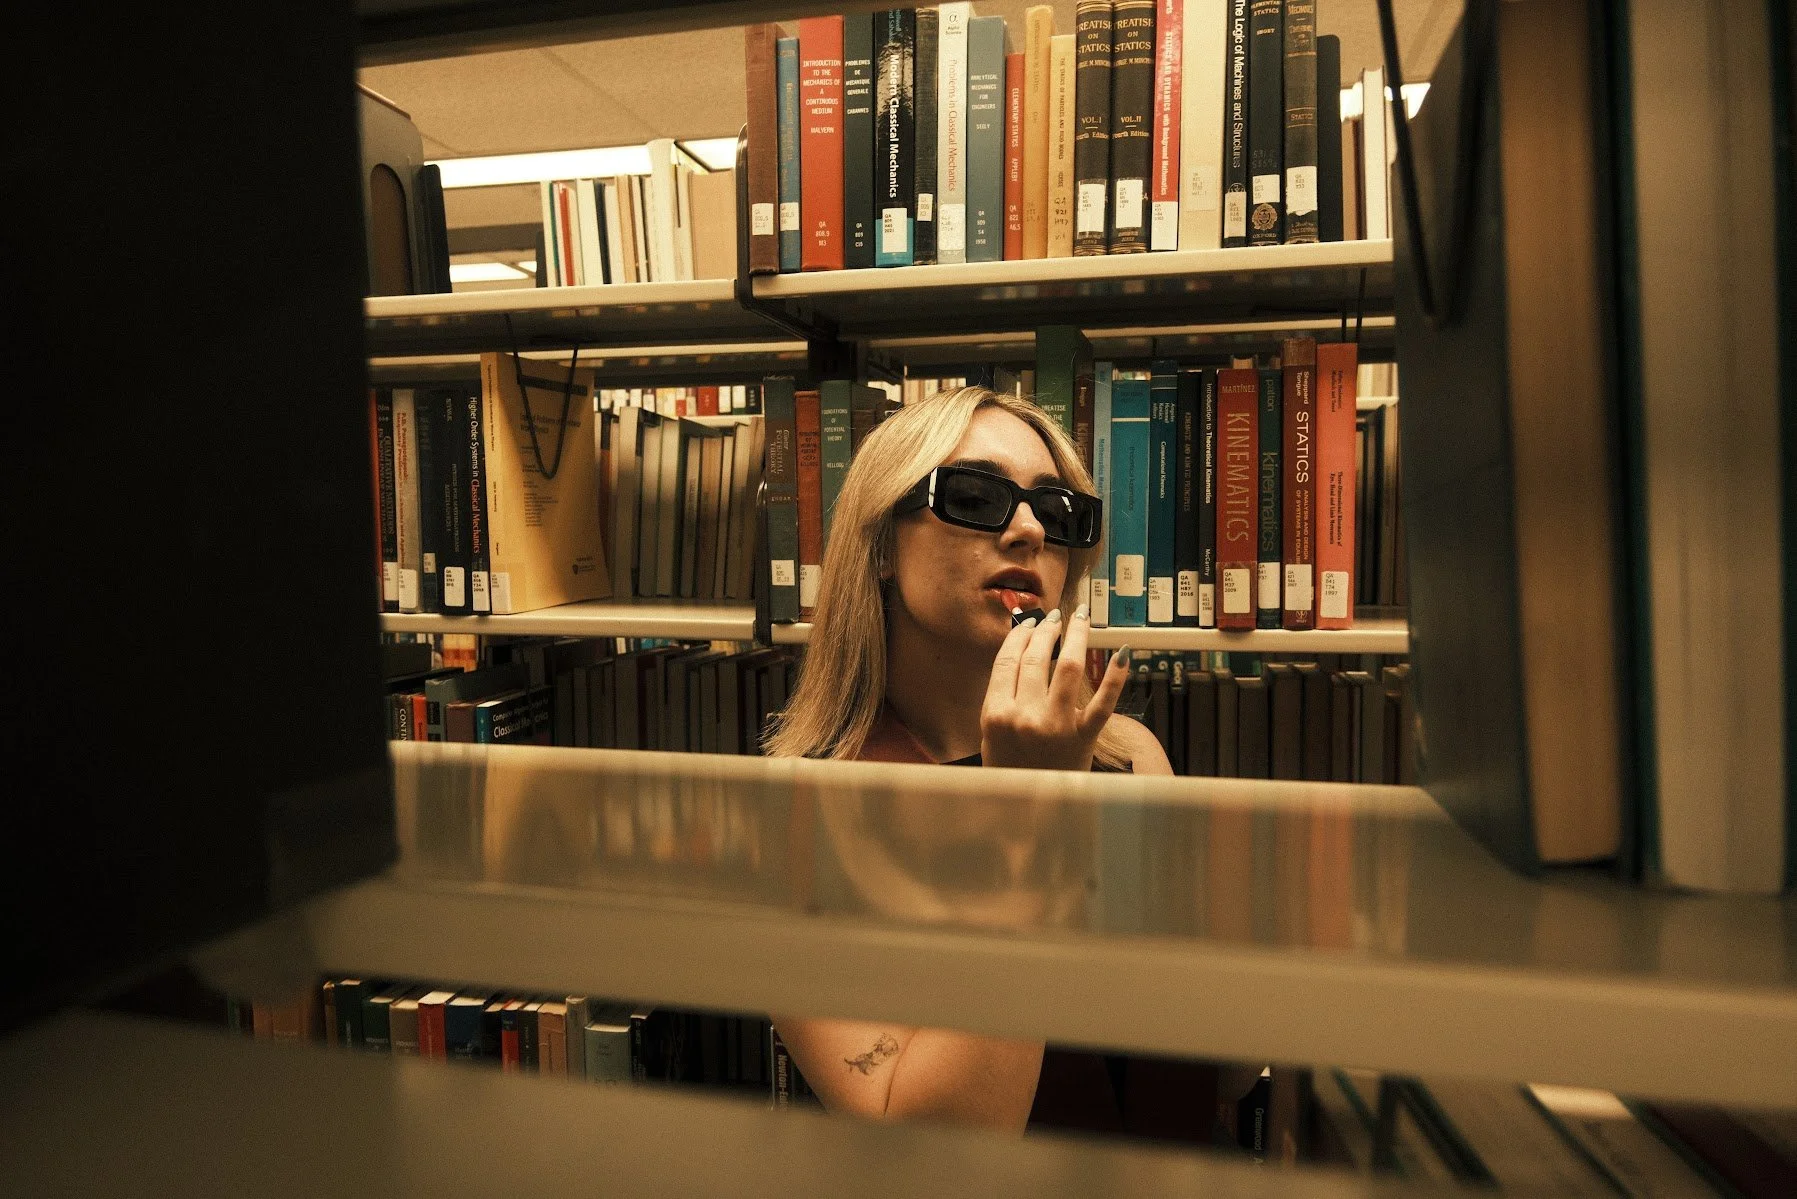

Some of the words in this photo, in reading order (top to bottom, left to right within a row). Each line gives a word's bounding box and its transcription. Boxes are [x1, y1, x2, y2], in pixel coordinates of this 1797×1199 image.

[1233, 18, 1245, 44] Logic
[1254, 8, 1280, 16] STATICS
[1114, 41, 1151, 52] STATICS
[1234, 46, 1244, 55] of
[890, 54, 900, 96] Modern
[949, 60, 958, 100] Problems
[1234, 56, 1244, 100] Machines
[890, 98, 900, 142] Classical
[949, 111, 958, 145] Classical
[1234, 103, 1243, 120] and
[1233, 122, 1243, 168] Structures
[890, 144, 900, 198] Mechanics
[949, 148, 958, 192] Mechanics
[468, 397, 478, 419] Higher
[471, 420, 479, 440] Order
[1296, 412, 1309, 483] STATICS
[470, 441, 479, 469] Systems
[471, 479, 481, 512] Classical
[1226, 413, 1250, 542] KINEMATICS
[1296, 490, 1301, 498] OF
[1262, 452, 1278, 551] kinematics
[472, 513, 482, 554] Mechanics
[1254, 1108, 1264, 1150] Greenwood
